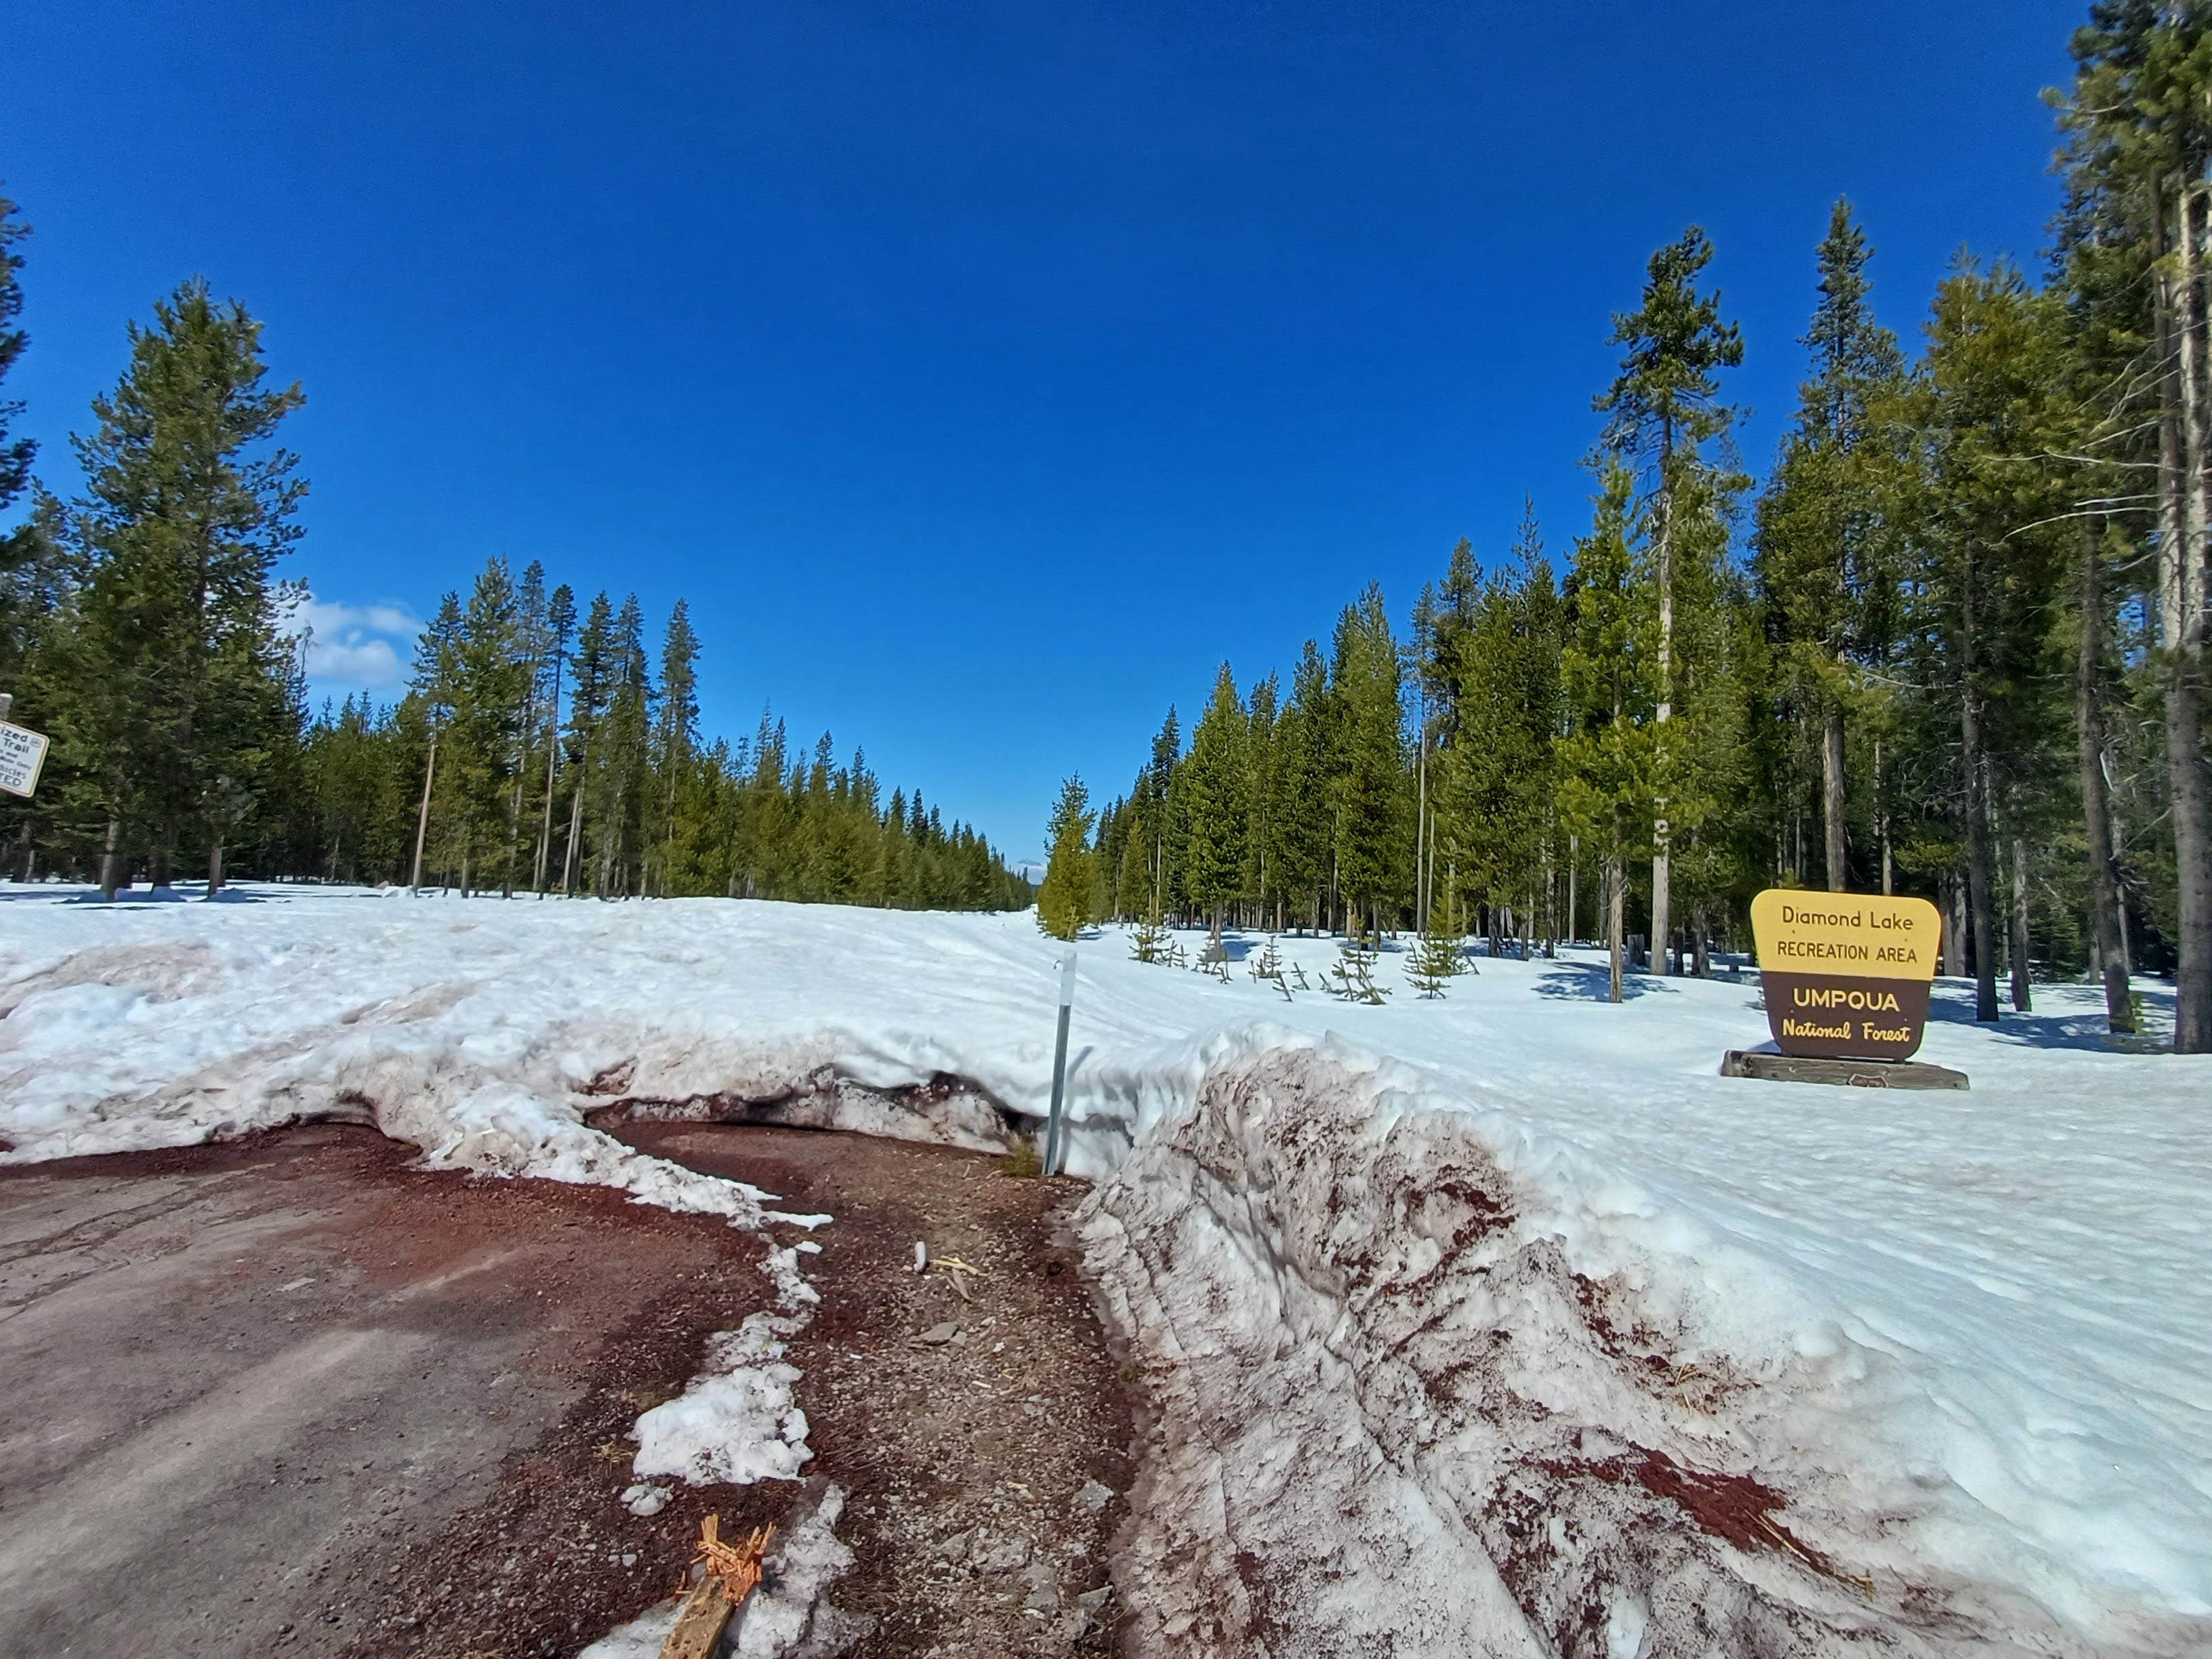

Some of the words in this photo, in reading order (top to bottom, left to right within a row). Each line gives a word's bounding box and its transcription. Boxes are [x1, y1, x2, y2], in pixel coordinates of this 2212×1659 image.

[3, 737, 30, 754] Trail
[1782, 906, 1861, 927] Diamond
[1870, 912, 1914, 930] Lake
[1778, 941, 1868, 960] RECREATION
[1876, 947, 1917, 963] AREA
[1793, 987, 1900, 1012] UMPQUA
[1782, 1019, 1851, 1040] National
[1862, 1022, 1911, 1042] Forest
